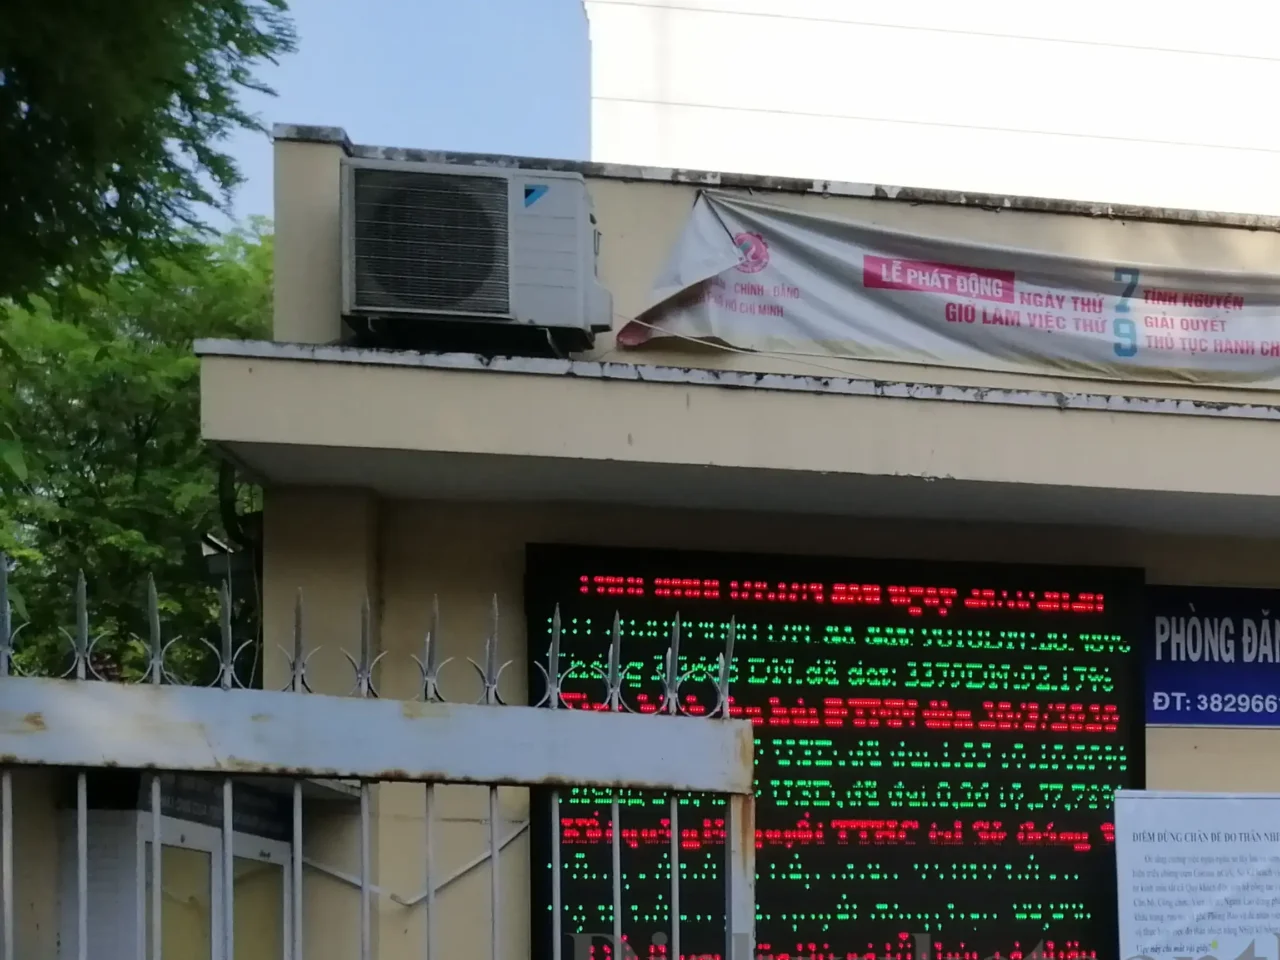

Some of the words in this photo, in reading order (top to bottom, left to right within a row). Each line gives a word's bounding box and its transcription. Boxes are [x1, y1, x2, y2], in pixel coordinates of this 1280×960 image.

[881, 261, 902, 284] LỄ
[907, 268, 951, 288] PHÁT
[956, 273, 1003, 298] ĐỘNG
[1019, 291, 1065, 312] NGÀY
[1070, 294, 1105, 314] THỨ
[1113, 267, 1140, 313] 7
[758, 303, 784, 317] MINH
[1143, 288, 1178, 305] TÌNH
[1182, 291, 1244, 313] NGUYỆN
[1026, 311, 1067, 333] VIỆC
[1071, 314, 1108, 334] THỨ
[1144, 311, 1175, 331] GIẢI
[1180, 316, 1227, 332] QUYẾT
[1112, 318, 1138, 357] 9
[1145, 332, 1175, 350] THỦ
[1179, 336, 1209, 355] TỤC
[1213, 336, 1255, 355] HÀNH
[1155, 602, 1235, 664] PHÒNG
[1153, 692, 1192, 712] ĐT:
